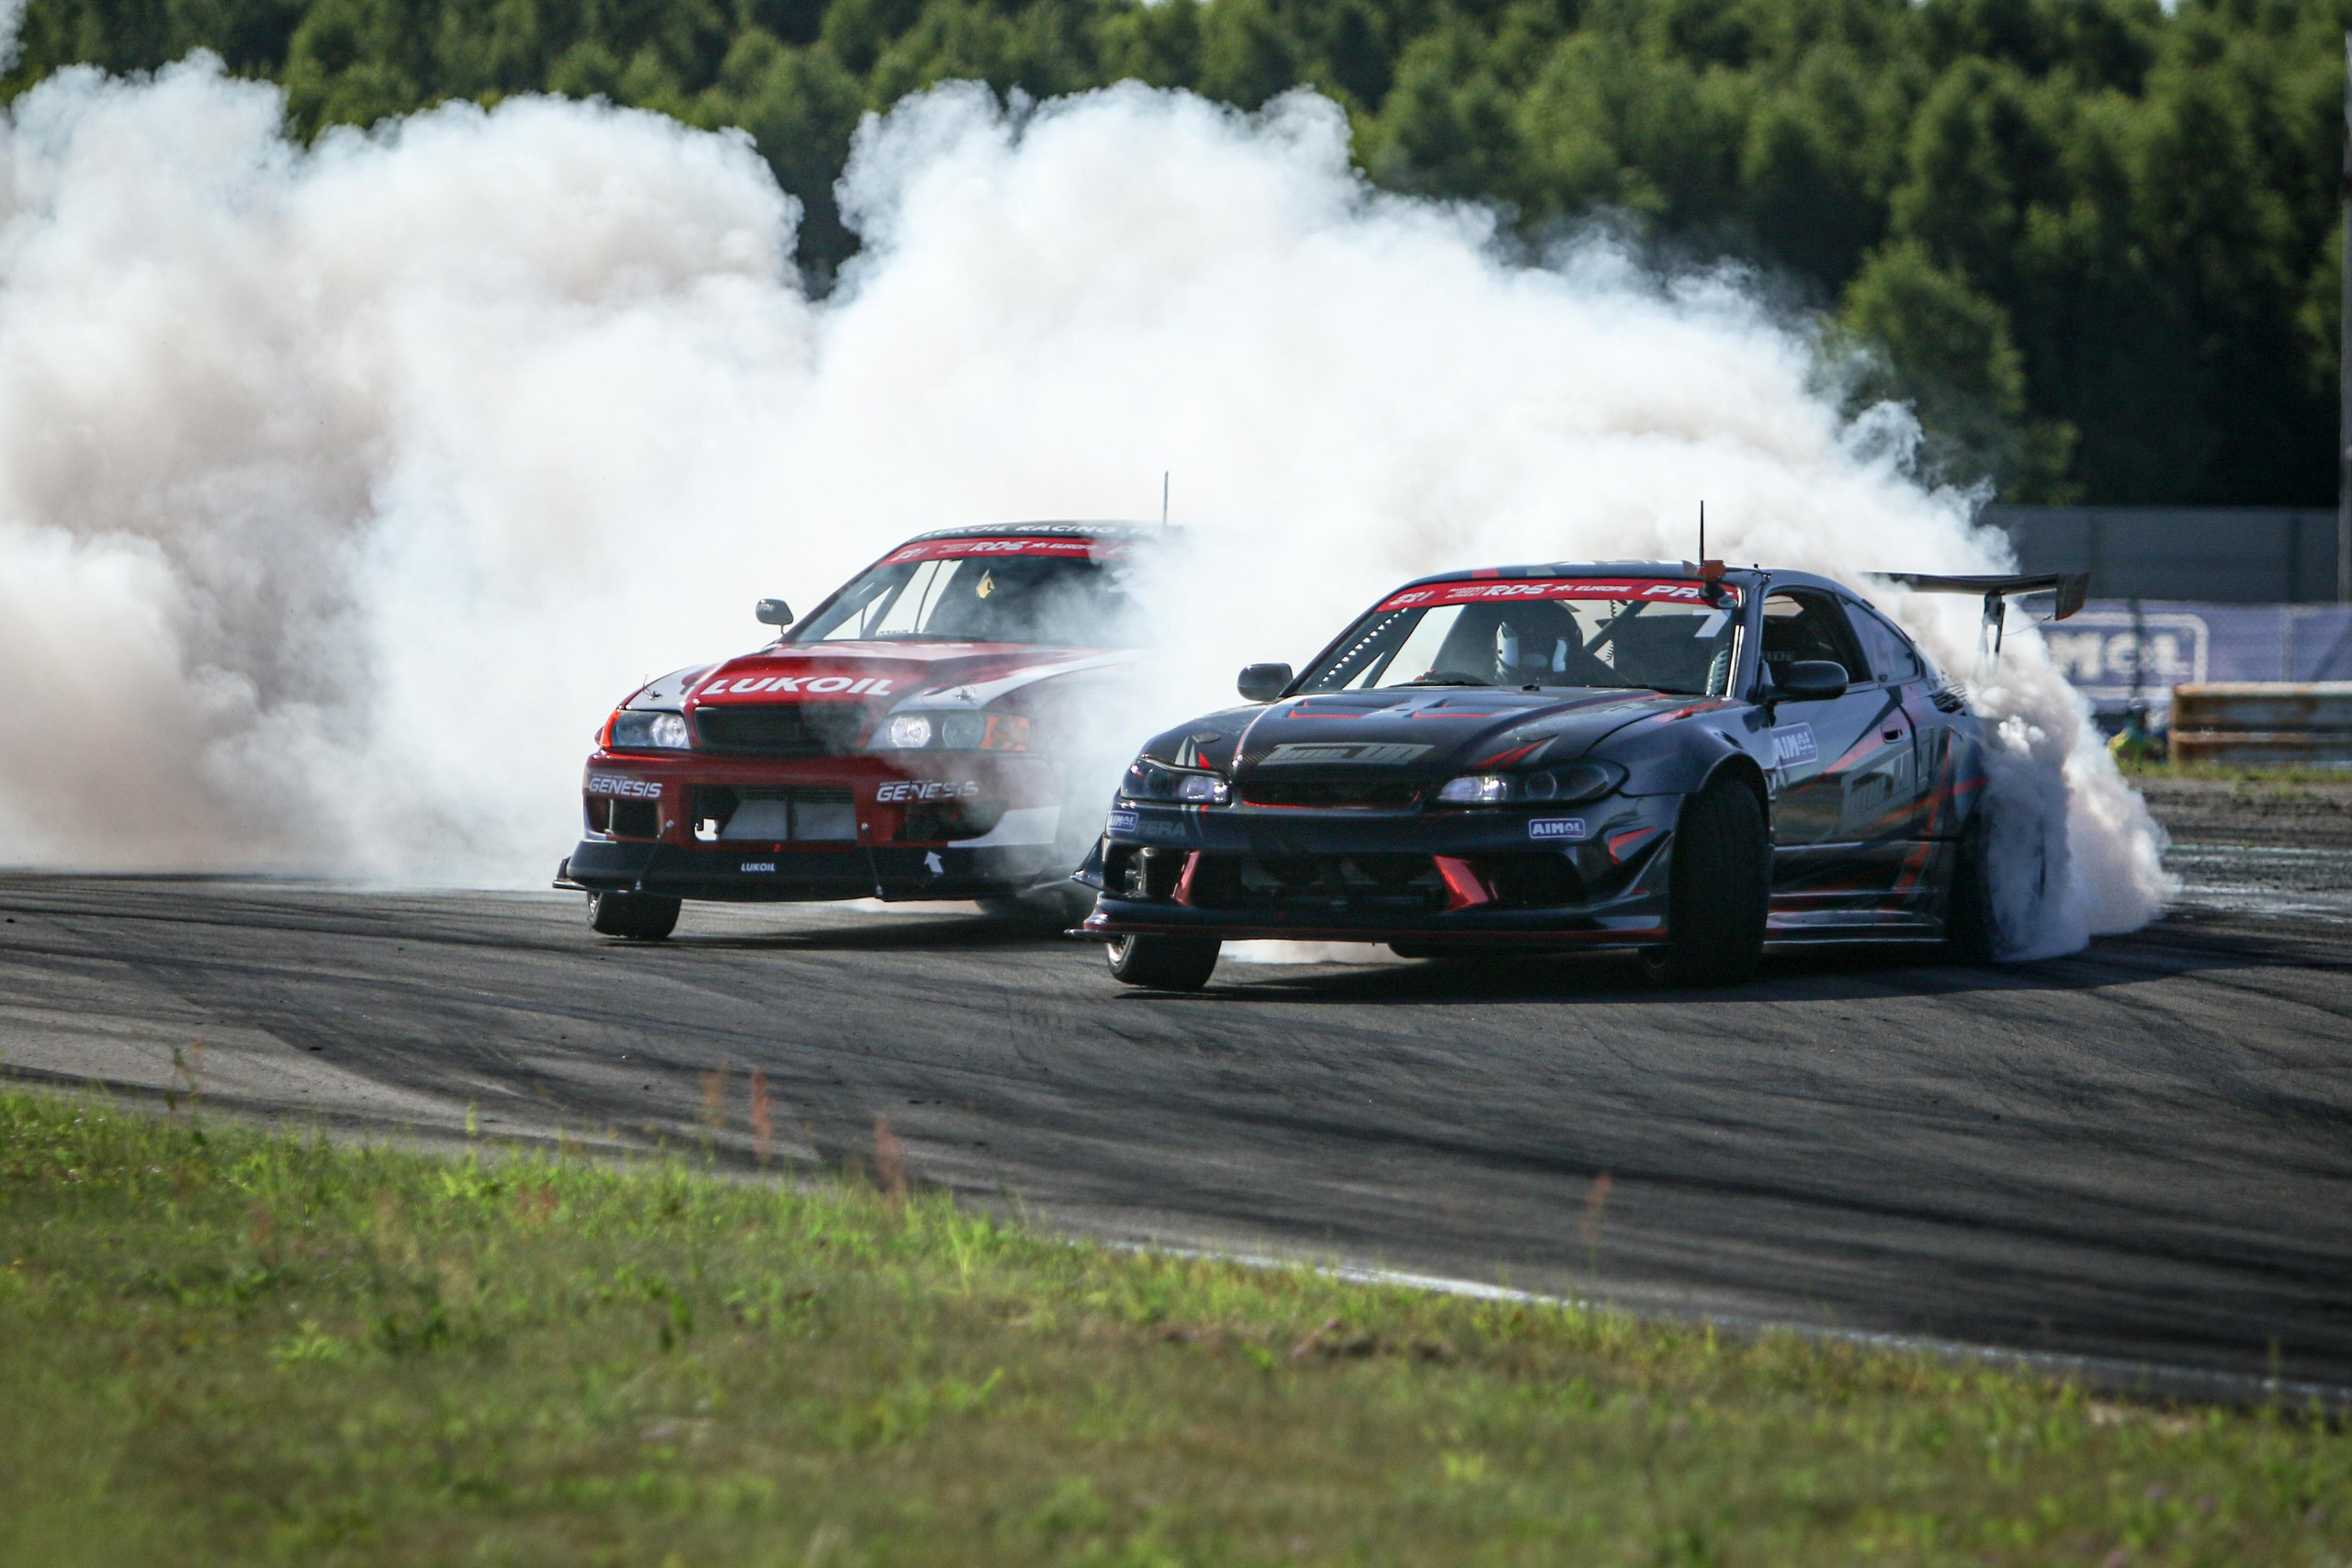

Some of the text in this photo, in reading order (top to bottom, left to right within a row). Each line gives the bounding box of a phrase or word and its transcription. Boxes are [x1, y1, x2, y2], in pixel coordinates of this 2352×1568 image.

[1015, 525, 1116, 534] RACING
[968, 541, 1031, 552] RDS
[1482, 583, 1553, 596] RDS
[1692, 609, 1731, 637] 7
[2047, 630, 2193, 681] MOL
[699, 677, 893, 696] LUKOIL
[1772, 731, 1814, 760] AIMOL
[589, 777, 662, 798] GENESIS
[1532, 823, 1582, 834] AIMOL
[741, 863, 775, 872] LUKOIL
